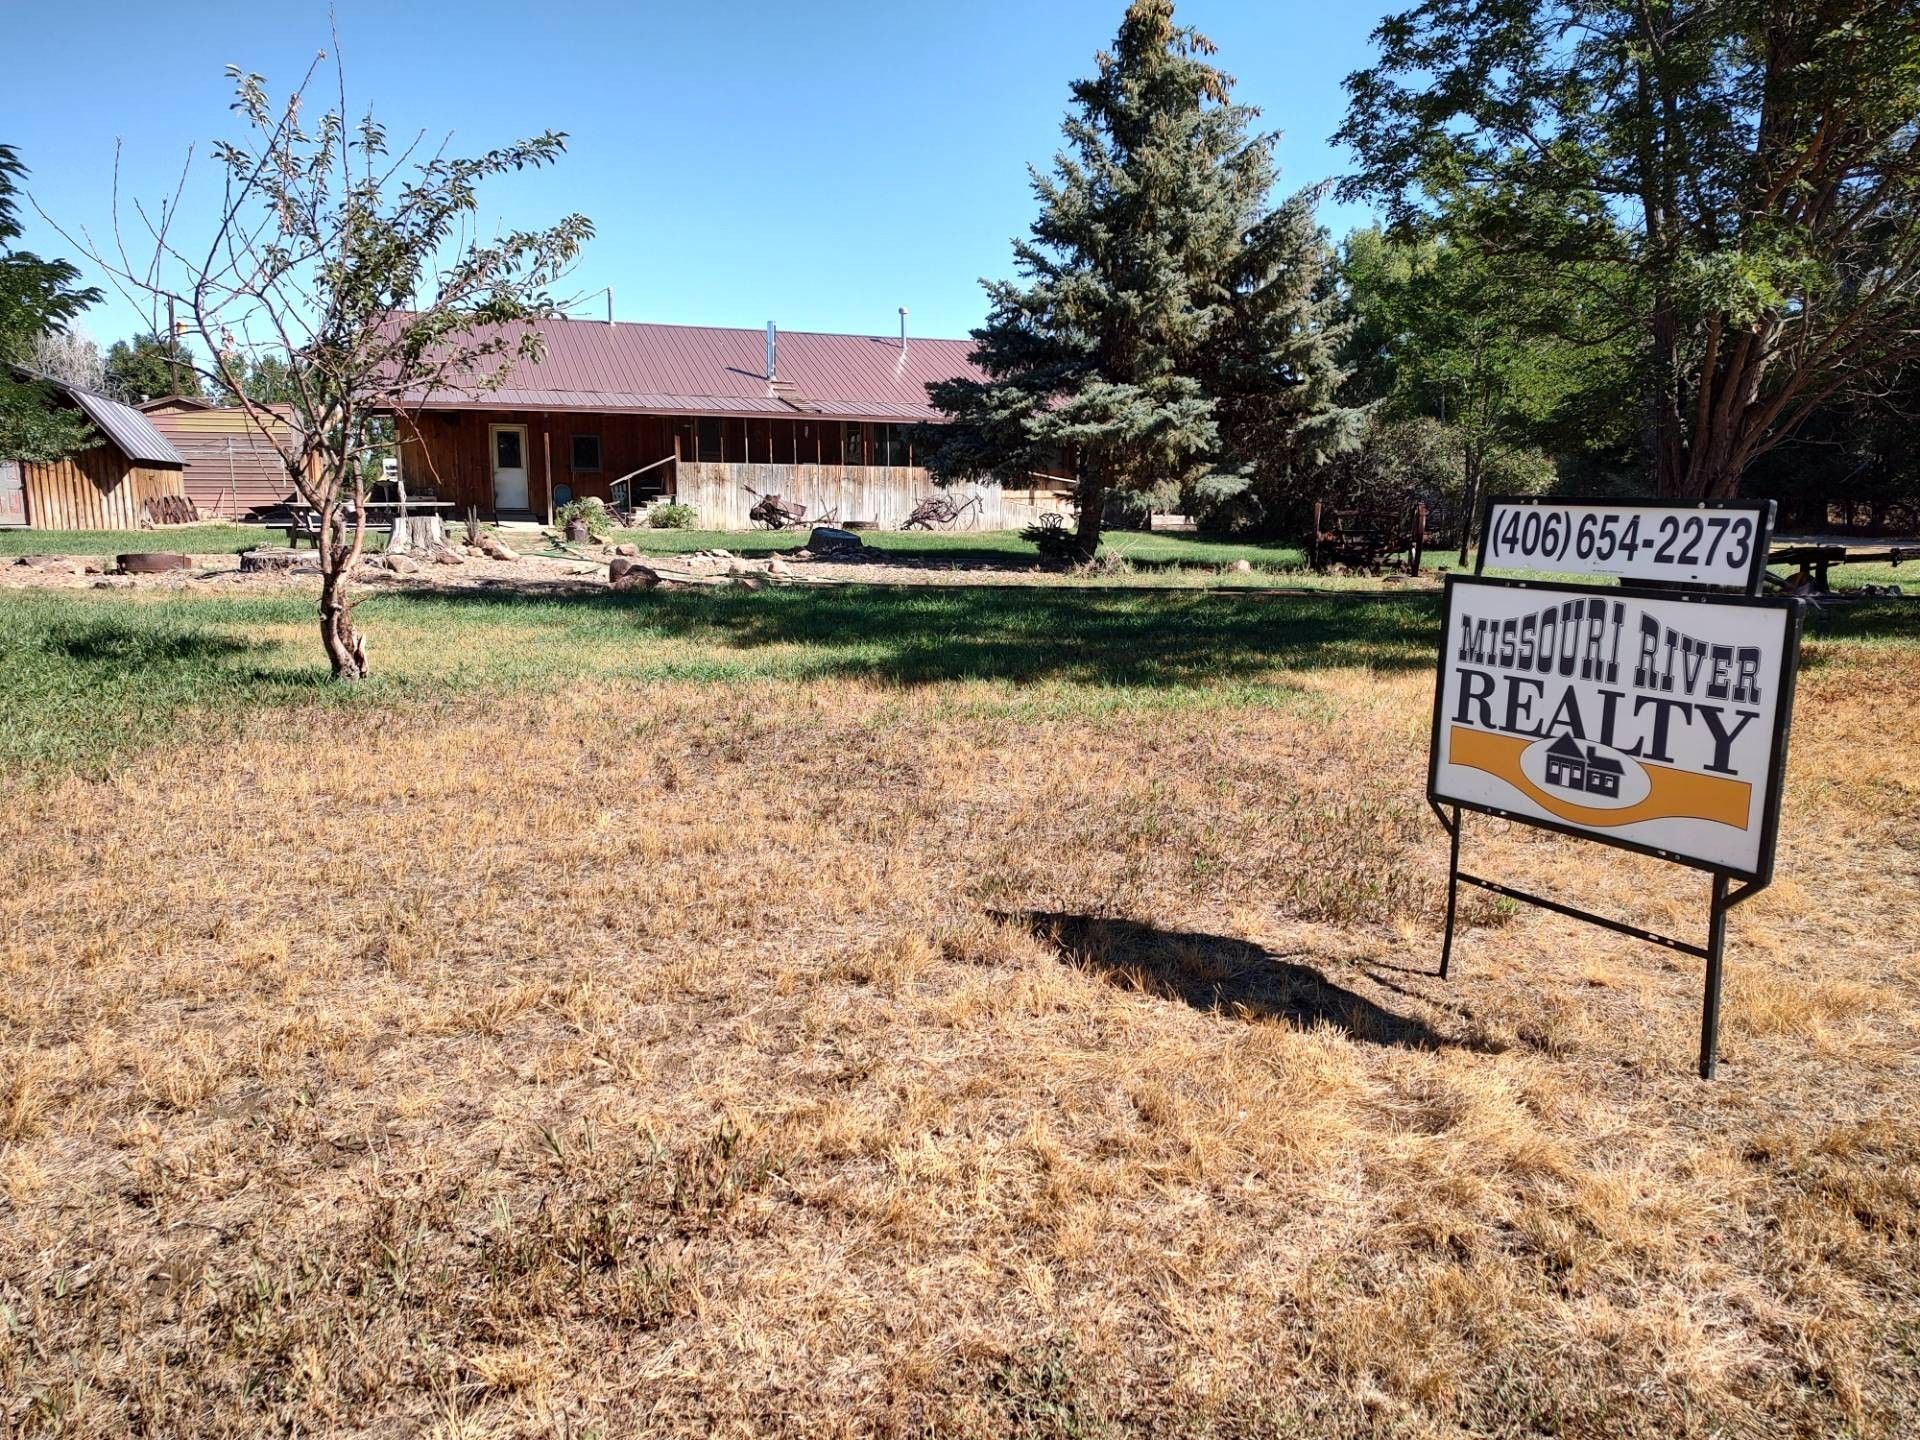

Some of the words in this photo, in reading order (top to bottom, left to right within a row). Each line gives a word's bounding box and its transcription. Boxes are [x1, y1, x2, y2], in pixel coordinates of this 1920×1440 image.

[1458, 598, 1626, 684] MISSOURI
[1633, 611, 1762, 705] RIVER
[1451, 668, 1760, 776] REALTY
